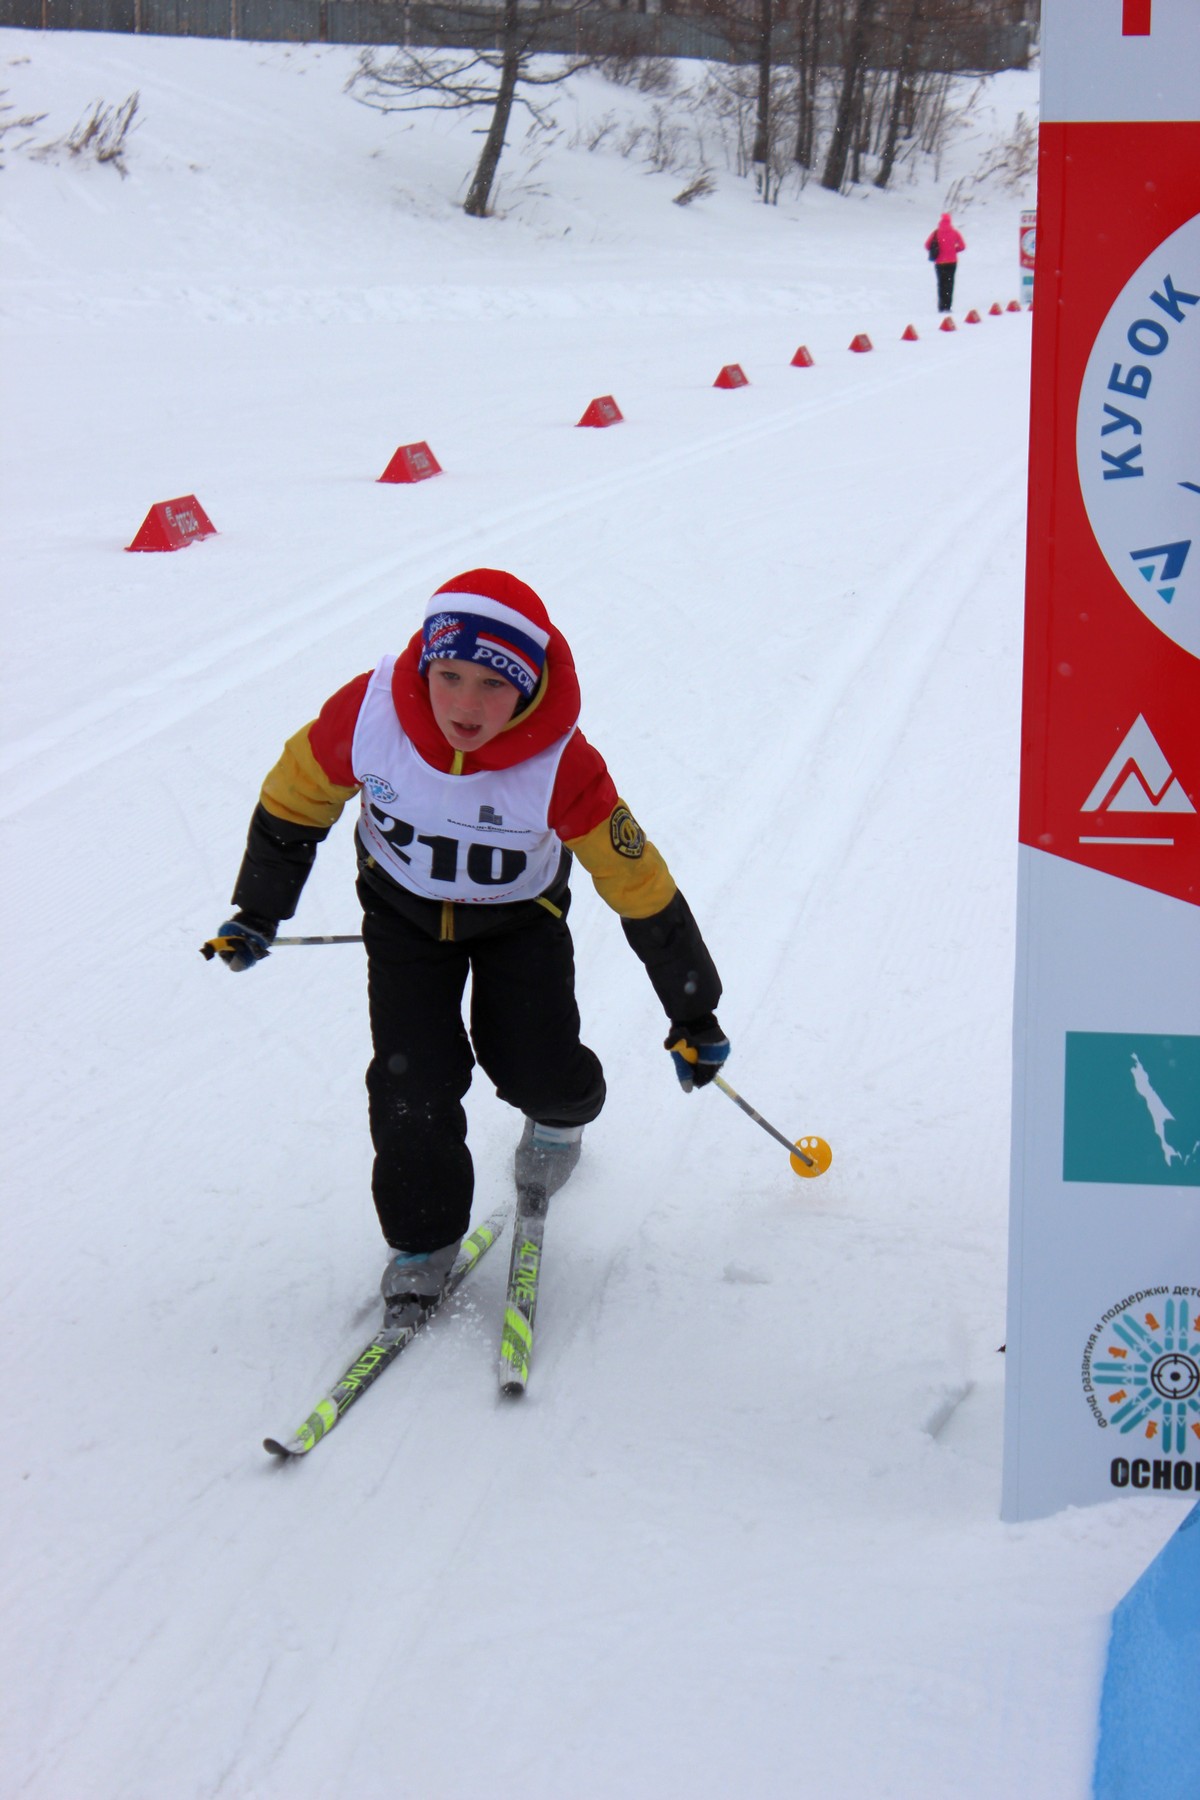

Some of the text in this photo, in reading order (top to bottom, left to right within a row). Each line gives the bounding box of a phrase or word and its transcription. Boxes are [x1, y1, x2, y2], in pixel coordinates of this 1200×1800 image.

[1100, 273, 1200, 480] КУБОК
[369, 803, 528, 885] 210
[515, 1240, 540, 1302] ACTIVE
[339, 1344, 388, 1391] ACTIVE
[1081, 1333, 1099, 1393] развития
[1100, 1285, 1170, 1324] поддержки
[1110, 1457, 1200, 1492] ОСНО
